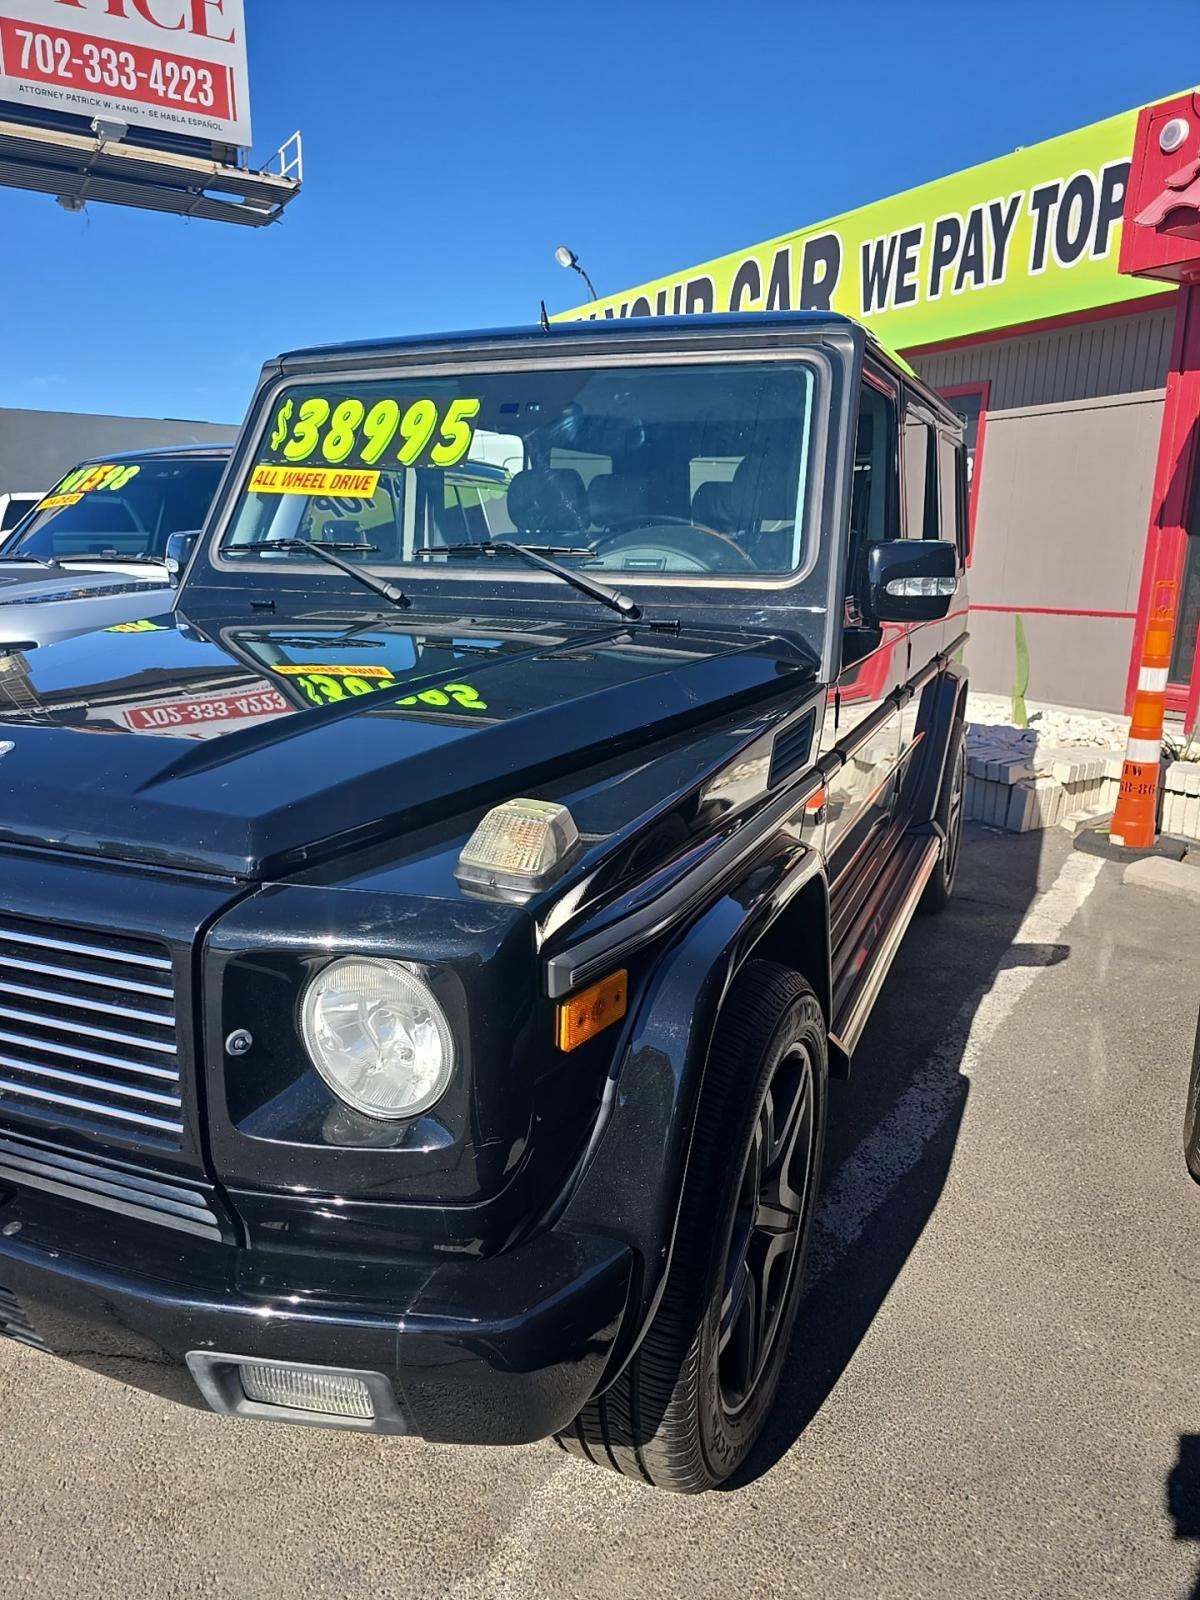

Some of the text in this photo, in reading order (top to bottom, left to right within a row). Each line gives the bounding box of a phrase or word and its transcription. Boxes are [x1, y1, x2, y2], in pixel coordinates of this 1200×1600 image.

[15, 28, 214, 107] 702-333-4223
[18, 84, 64, 100] ATTORNEY
[66, 93, 101, 107] PATRICK
[148, 109, 159, 119] SE
[160, 112, 186, 124] HABLA
[188, 117, 224, 131] ESPAÑOL
[728, 232, 842, 313] CAR
[862, 227, 922, 313] WE
[929, 195, 1022, 296] PAY
[1030, 162, 1131, 272] TOP
[270, 398, 480, 466] $38995
[252, 470, 375, 492] ALL WHEEL DRIVE
